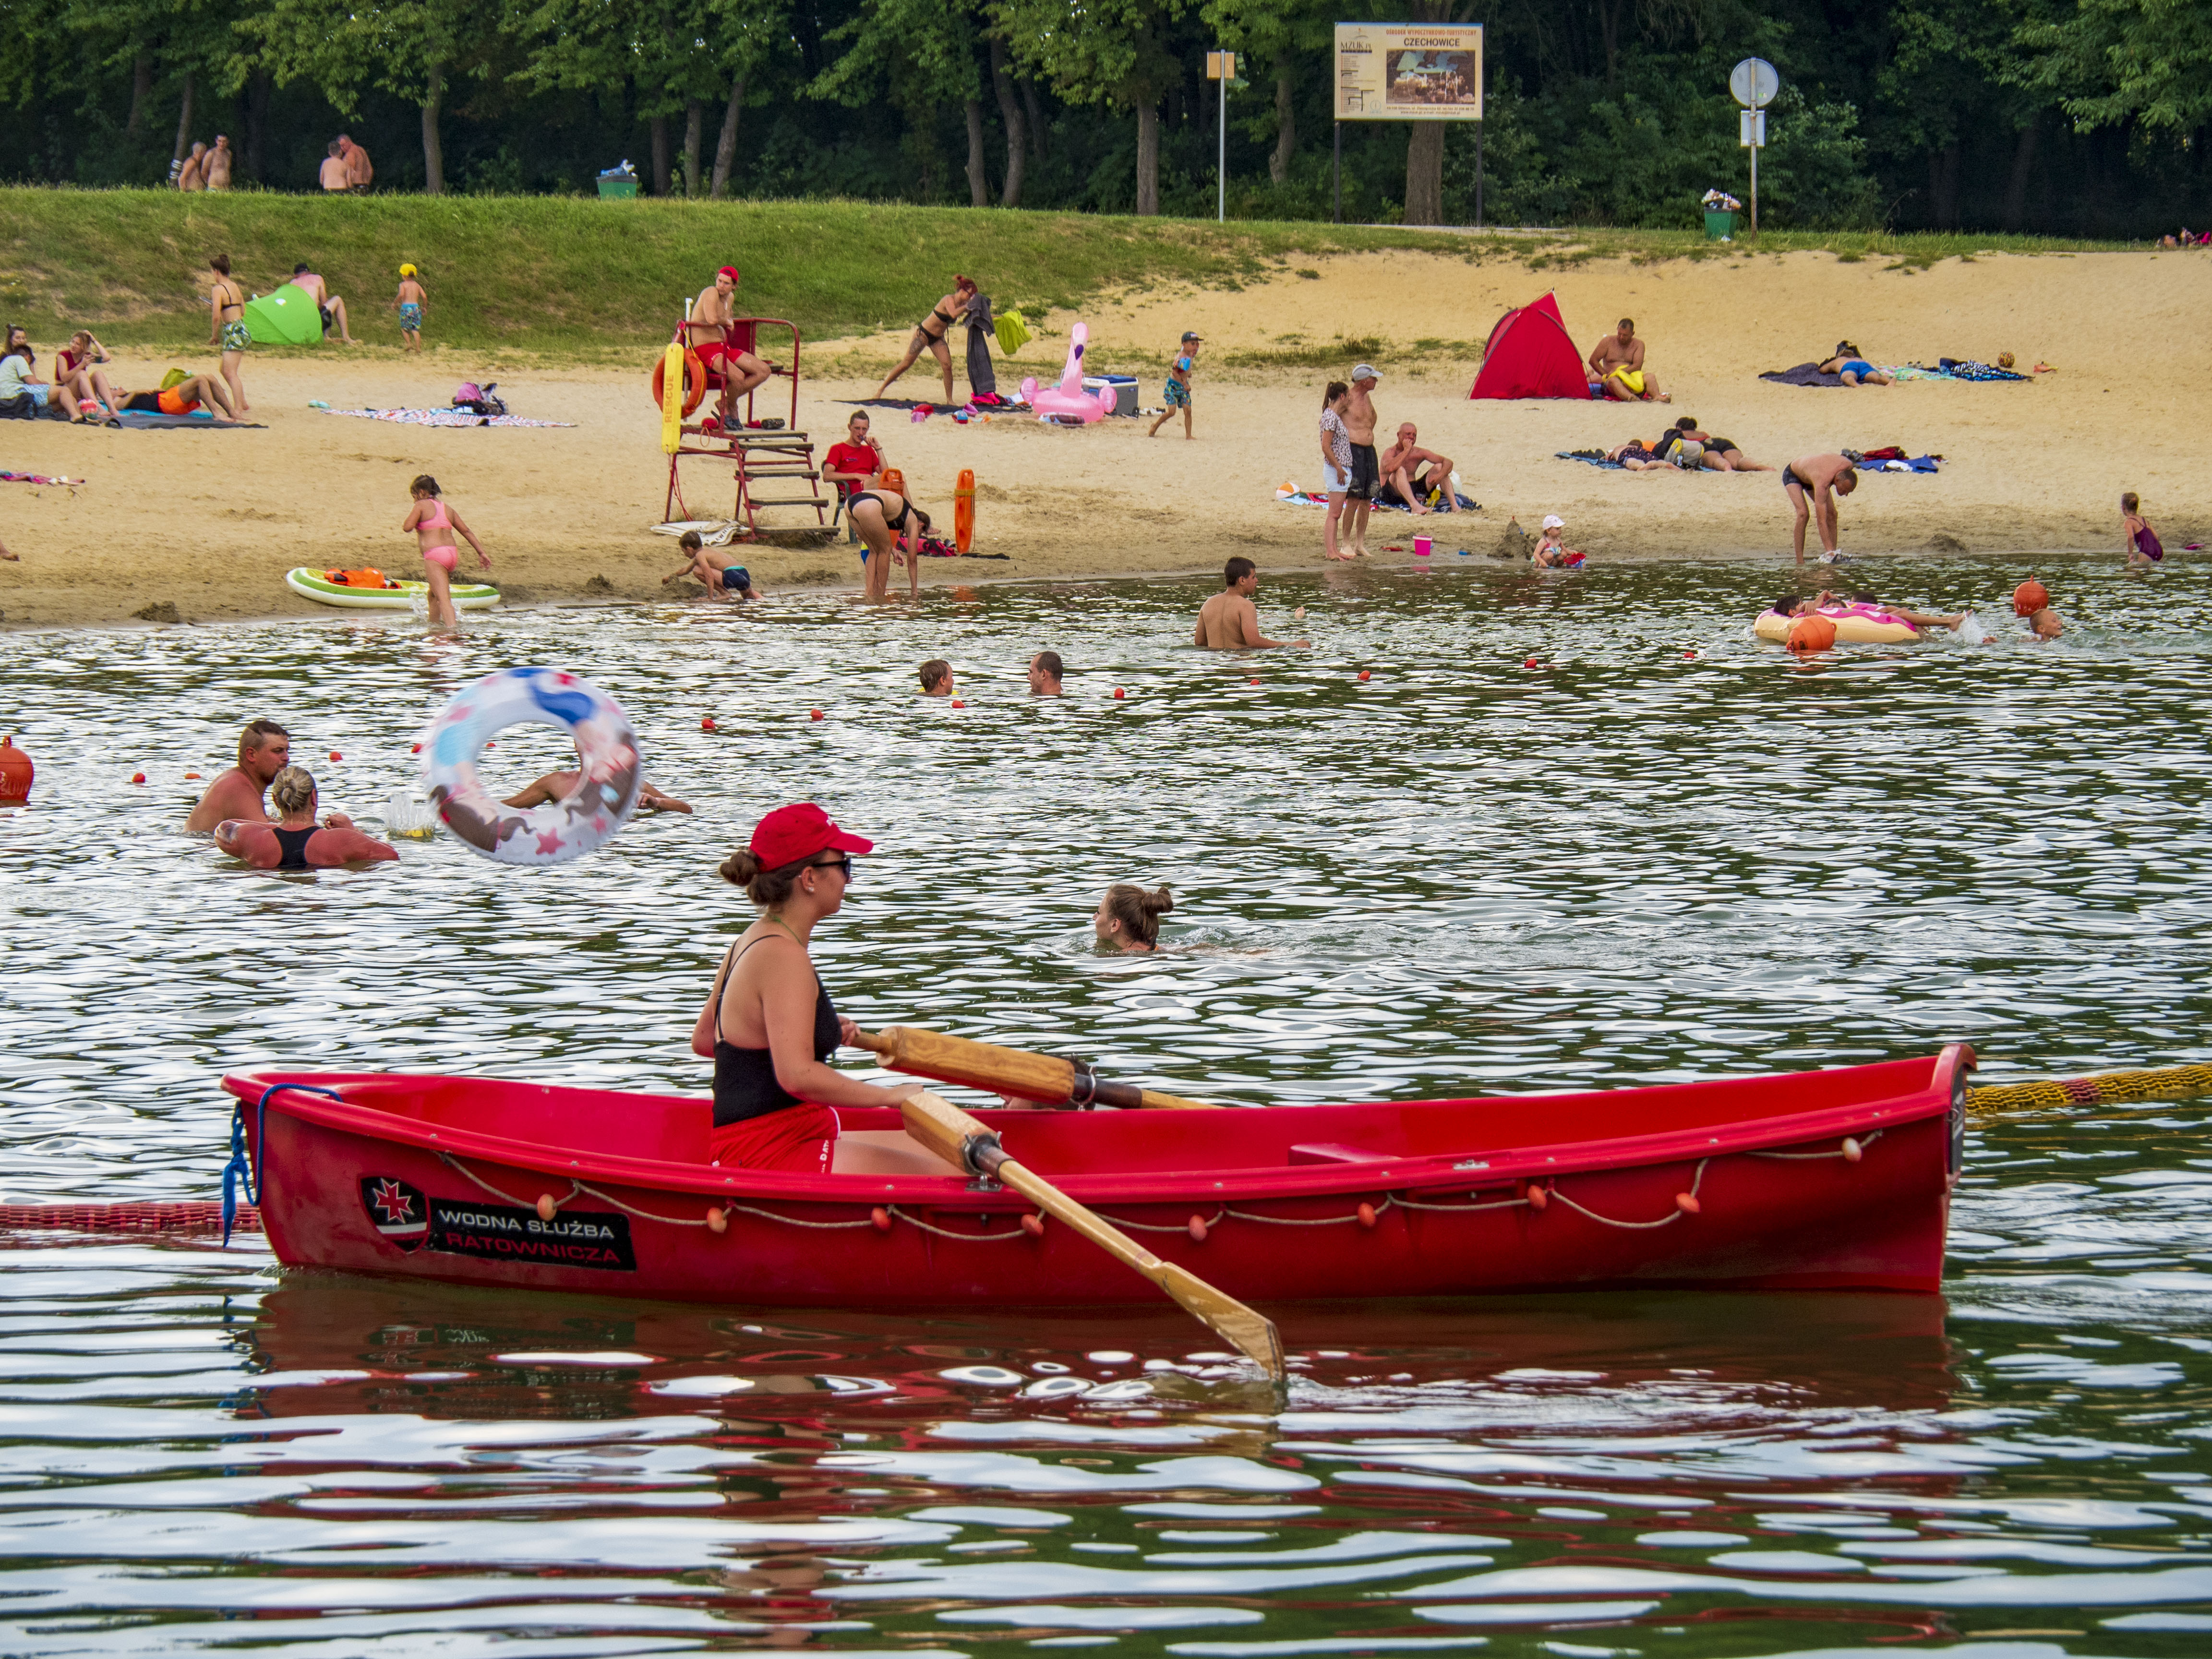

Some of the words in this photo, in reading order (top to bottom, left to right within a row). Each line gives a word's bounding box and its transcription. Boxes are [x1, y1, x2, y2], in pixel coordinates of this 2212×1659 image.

[1404, 37, 1460, 47] CZECHOWICE
[664, 375, 674, 423] RESCUE
[438, 1209, 522, 1230] WODNA
[527, 1219, 615, 1238] SŁUŻBA
[445, 1232, 621, 1263] RATOWNICZA
